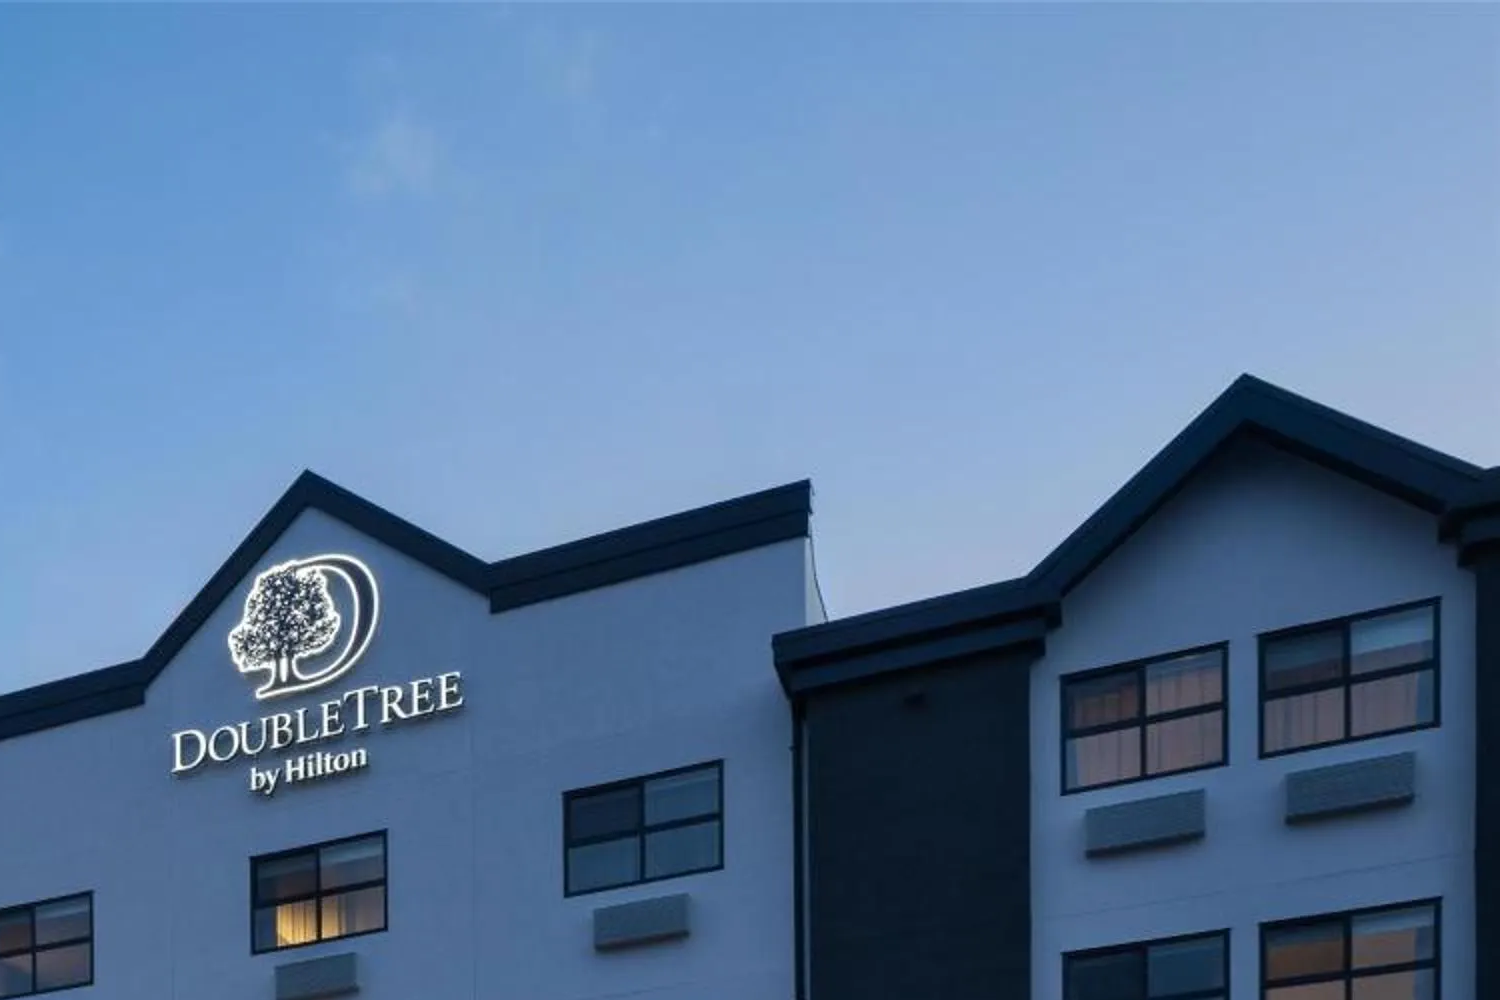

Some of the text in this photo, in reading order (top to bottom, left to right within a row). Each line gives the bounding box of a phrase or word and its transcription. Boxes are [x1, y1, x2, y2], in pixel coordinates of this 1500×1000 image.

[171, 671, 464, 774] DOUBLETREE
[249, 747, 368, 794] by Hilton
